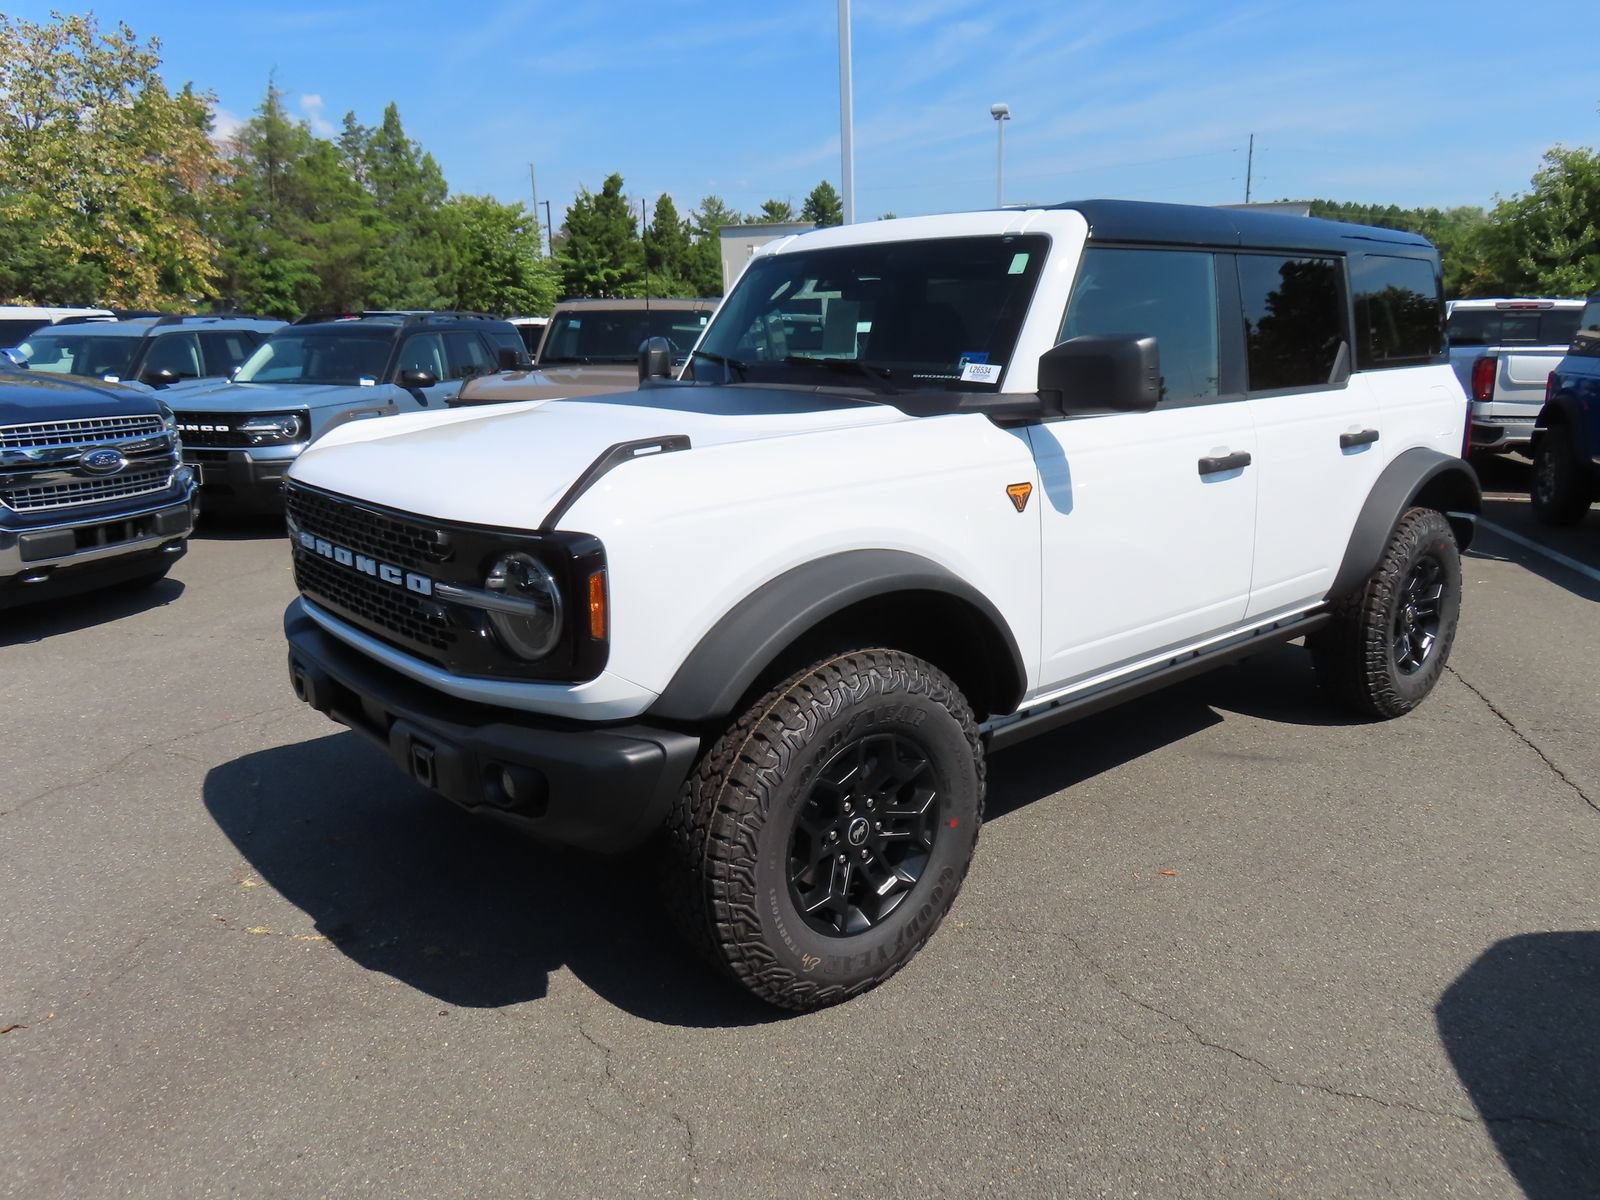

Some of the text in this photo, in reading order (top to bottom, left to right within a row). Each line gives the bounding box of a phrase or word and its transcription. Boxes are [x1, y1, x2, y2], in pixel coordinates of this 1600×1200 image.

[968, 365, 992, 375] L26534
[176, 424, 230, 432] ONCO
[299, 531, 433, 597] BRONCO
